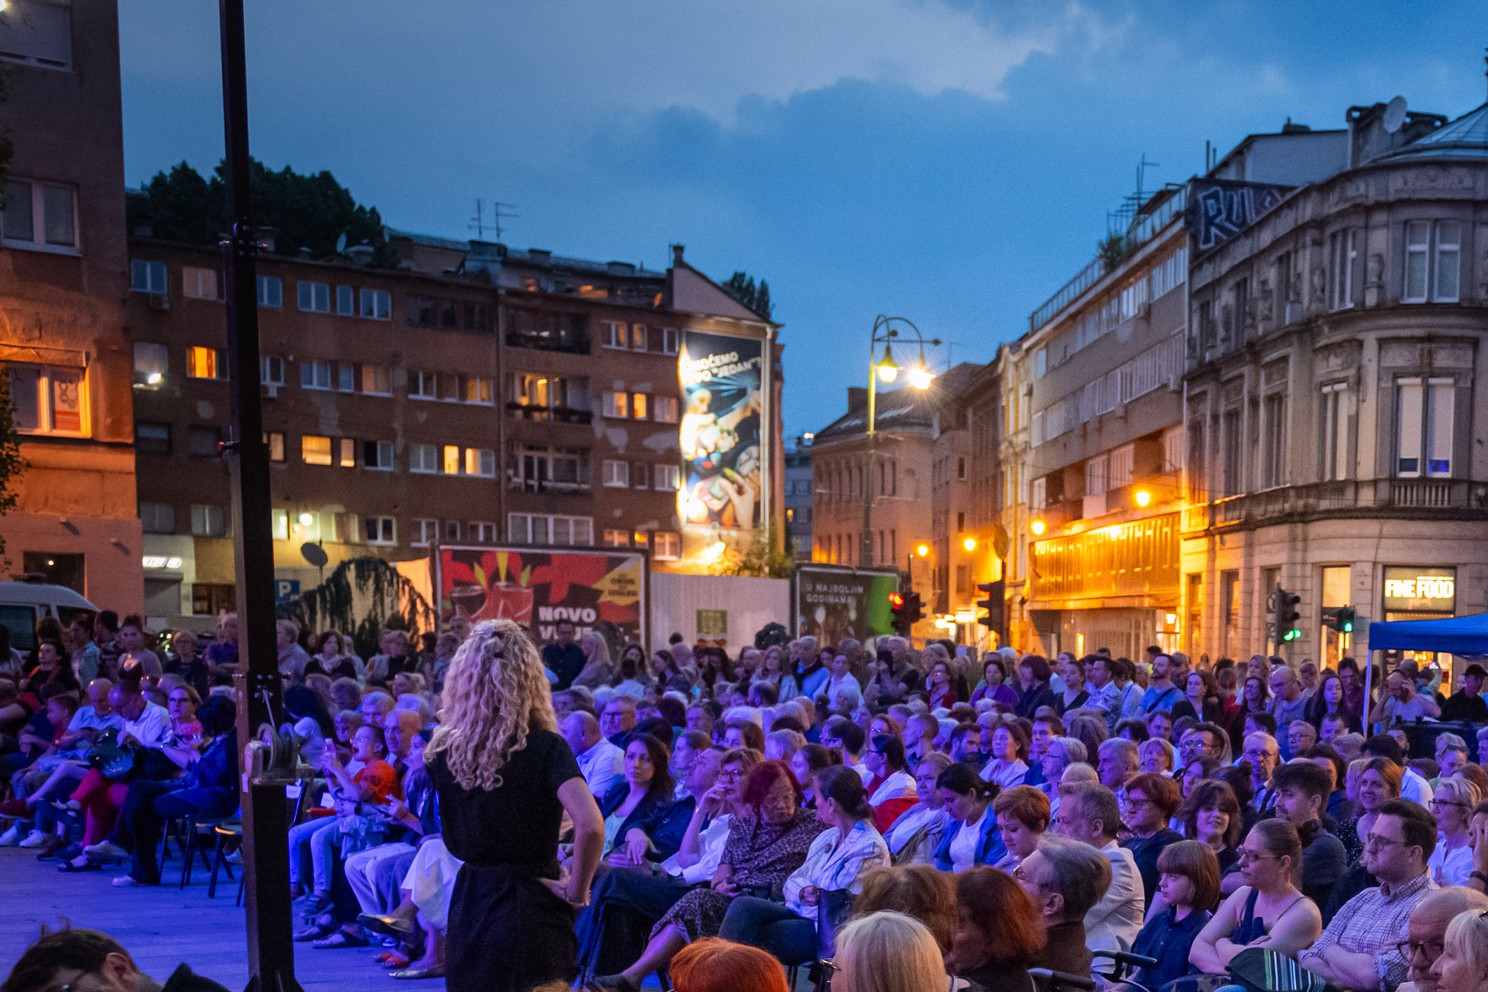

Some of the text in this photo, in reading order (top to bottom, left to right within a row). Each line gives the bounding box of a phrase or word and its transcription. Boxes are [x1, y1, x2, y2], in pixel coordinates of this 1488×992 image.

[278, 581, 291, 598] P
[1384, 579, 1454, 599] FINE FOOD
[538, 606, 597, 623] NOVO
